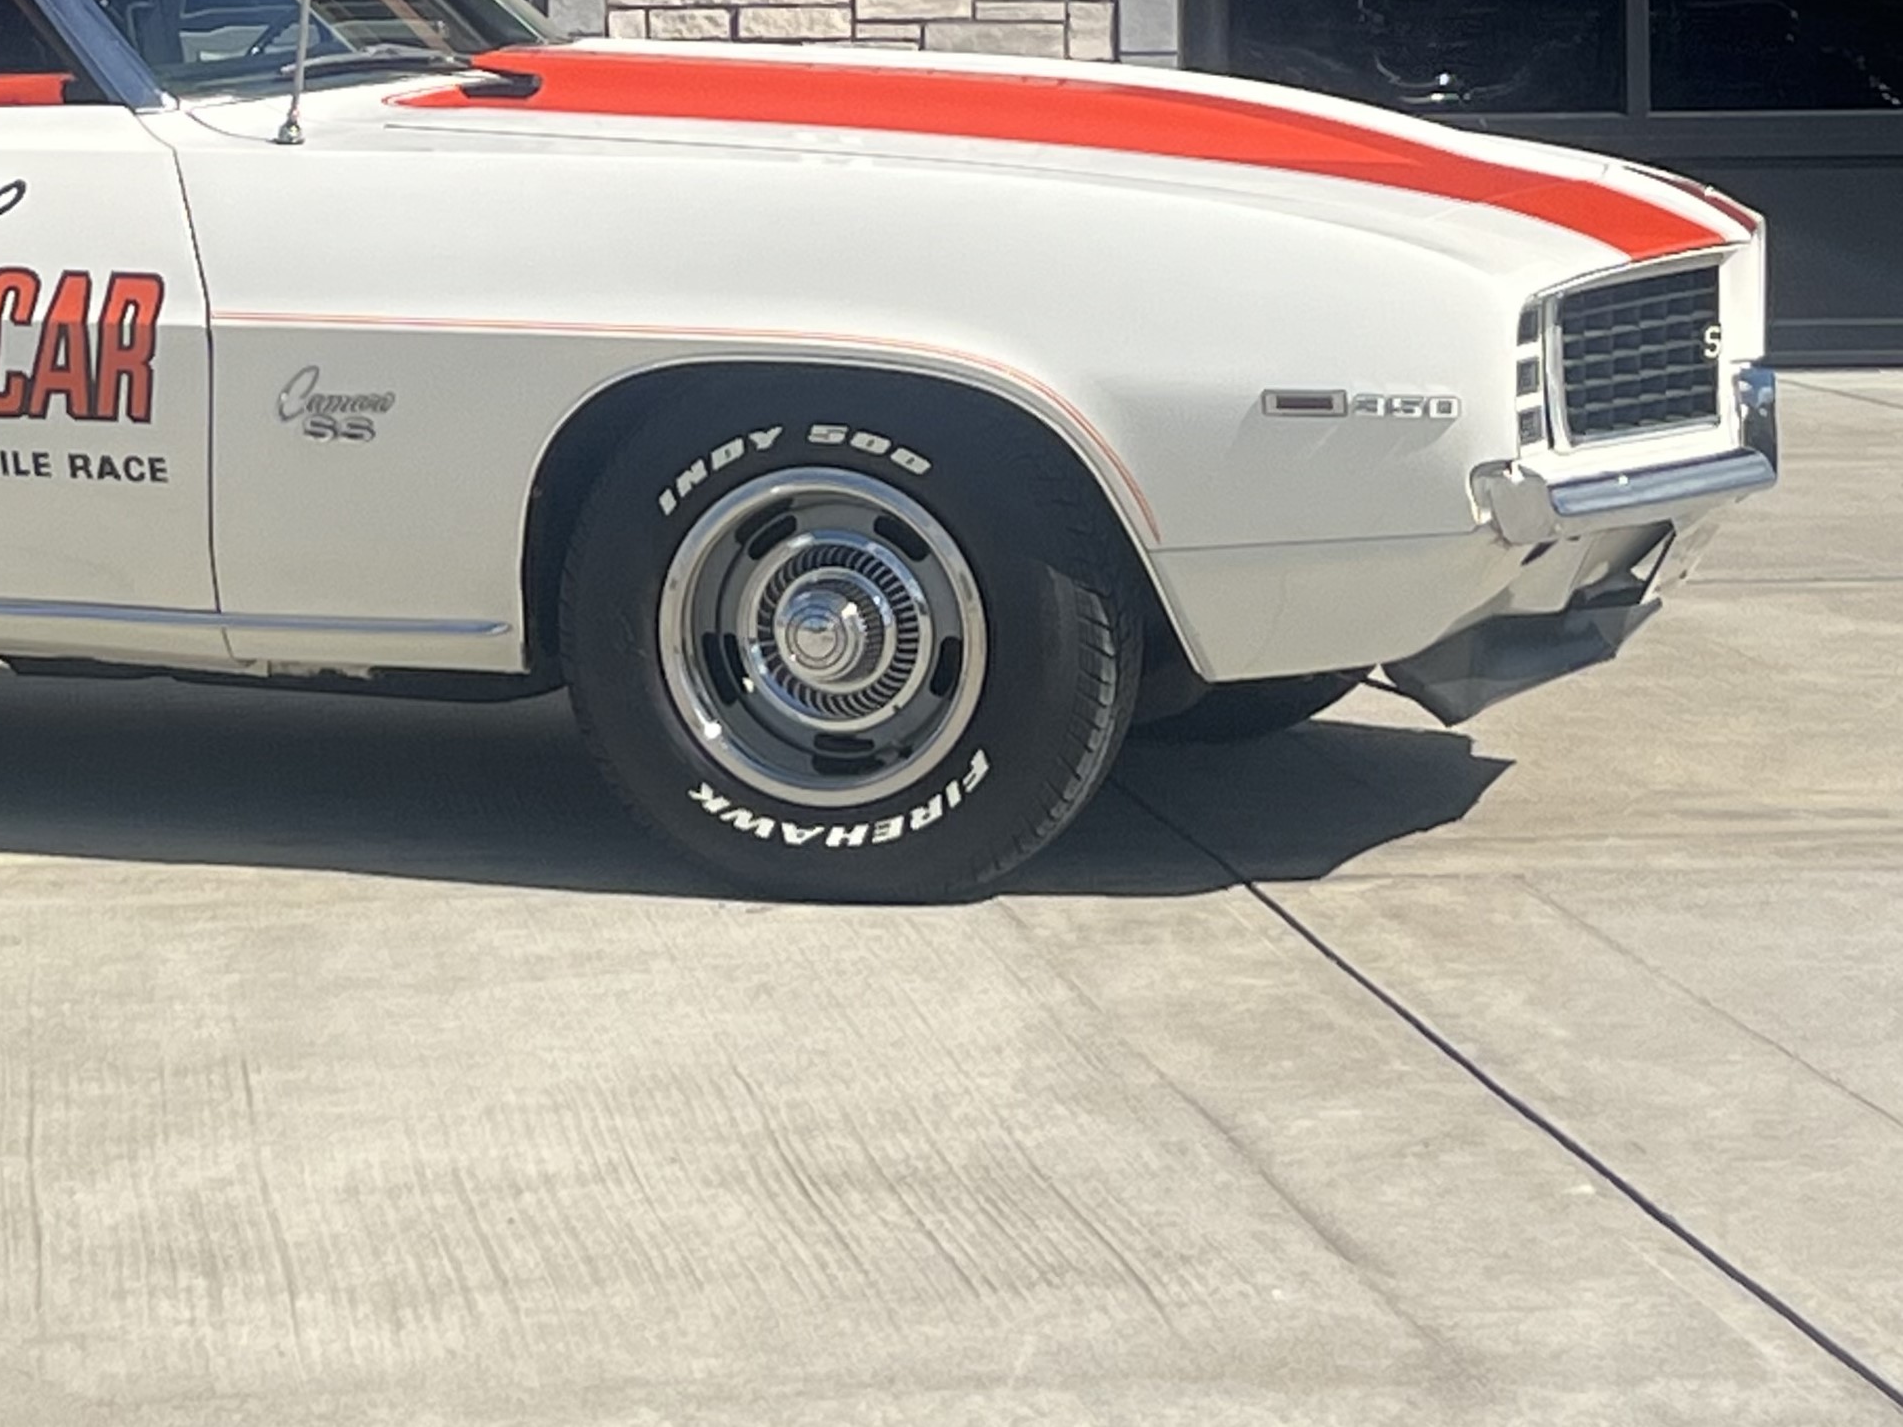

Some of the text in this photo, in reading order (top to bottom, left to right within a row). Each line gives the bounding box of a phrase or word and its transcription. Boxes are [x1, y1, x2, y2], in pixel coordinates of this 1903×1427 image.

[277, 365, 395, 422] Camaro
[1352, 393, 1460, 418] 350
[302, 414, 376, 442] SS
[68, 453, 169, 483] RACE
[658, 424, 932, 515] INDY 500
[688, 749, 990, 847] FIREHAWK
